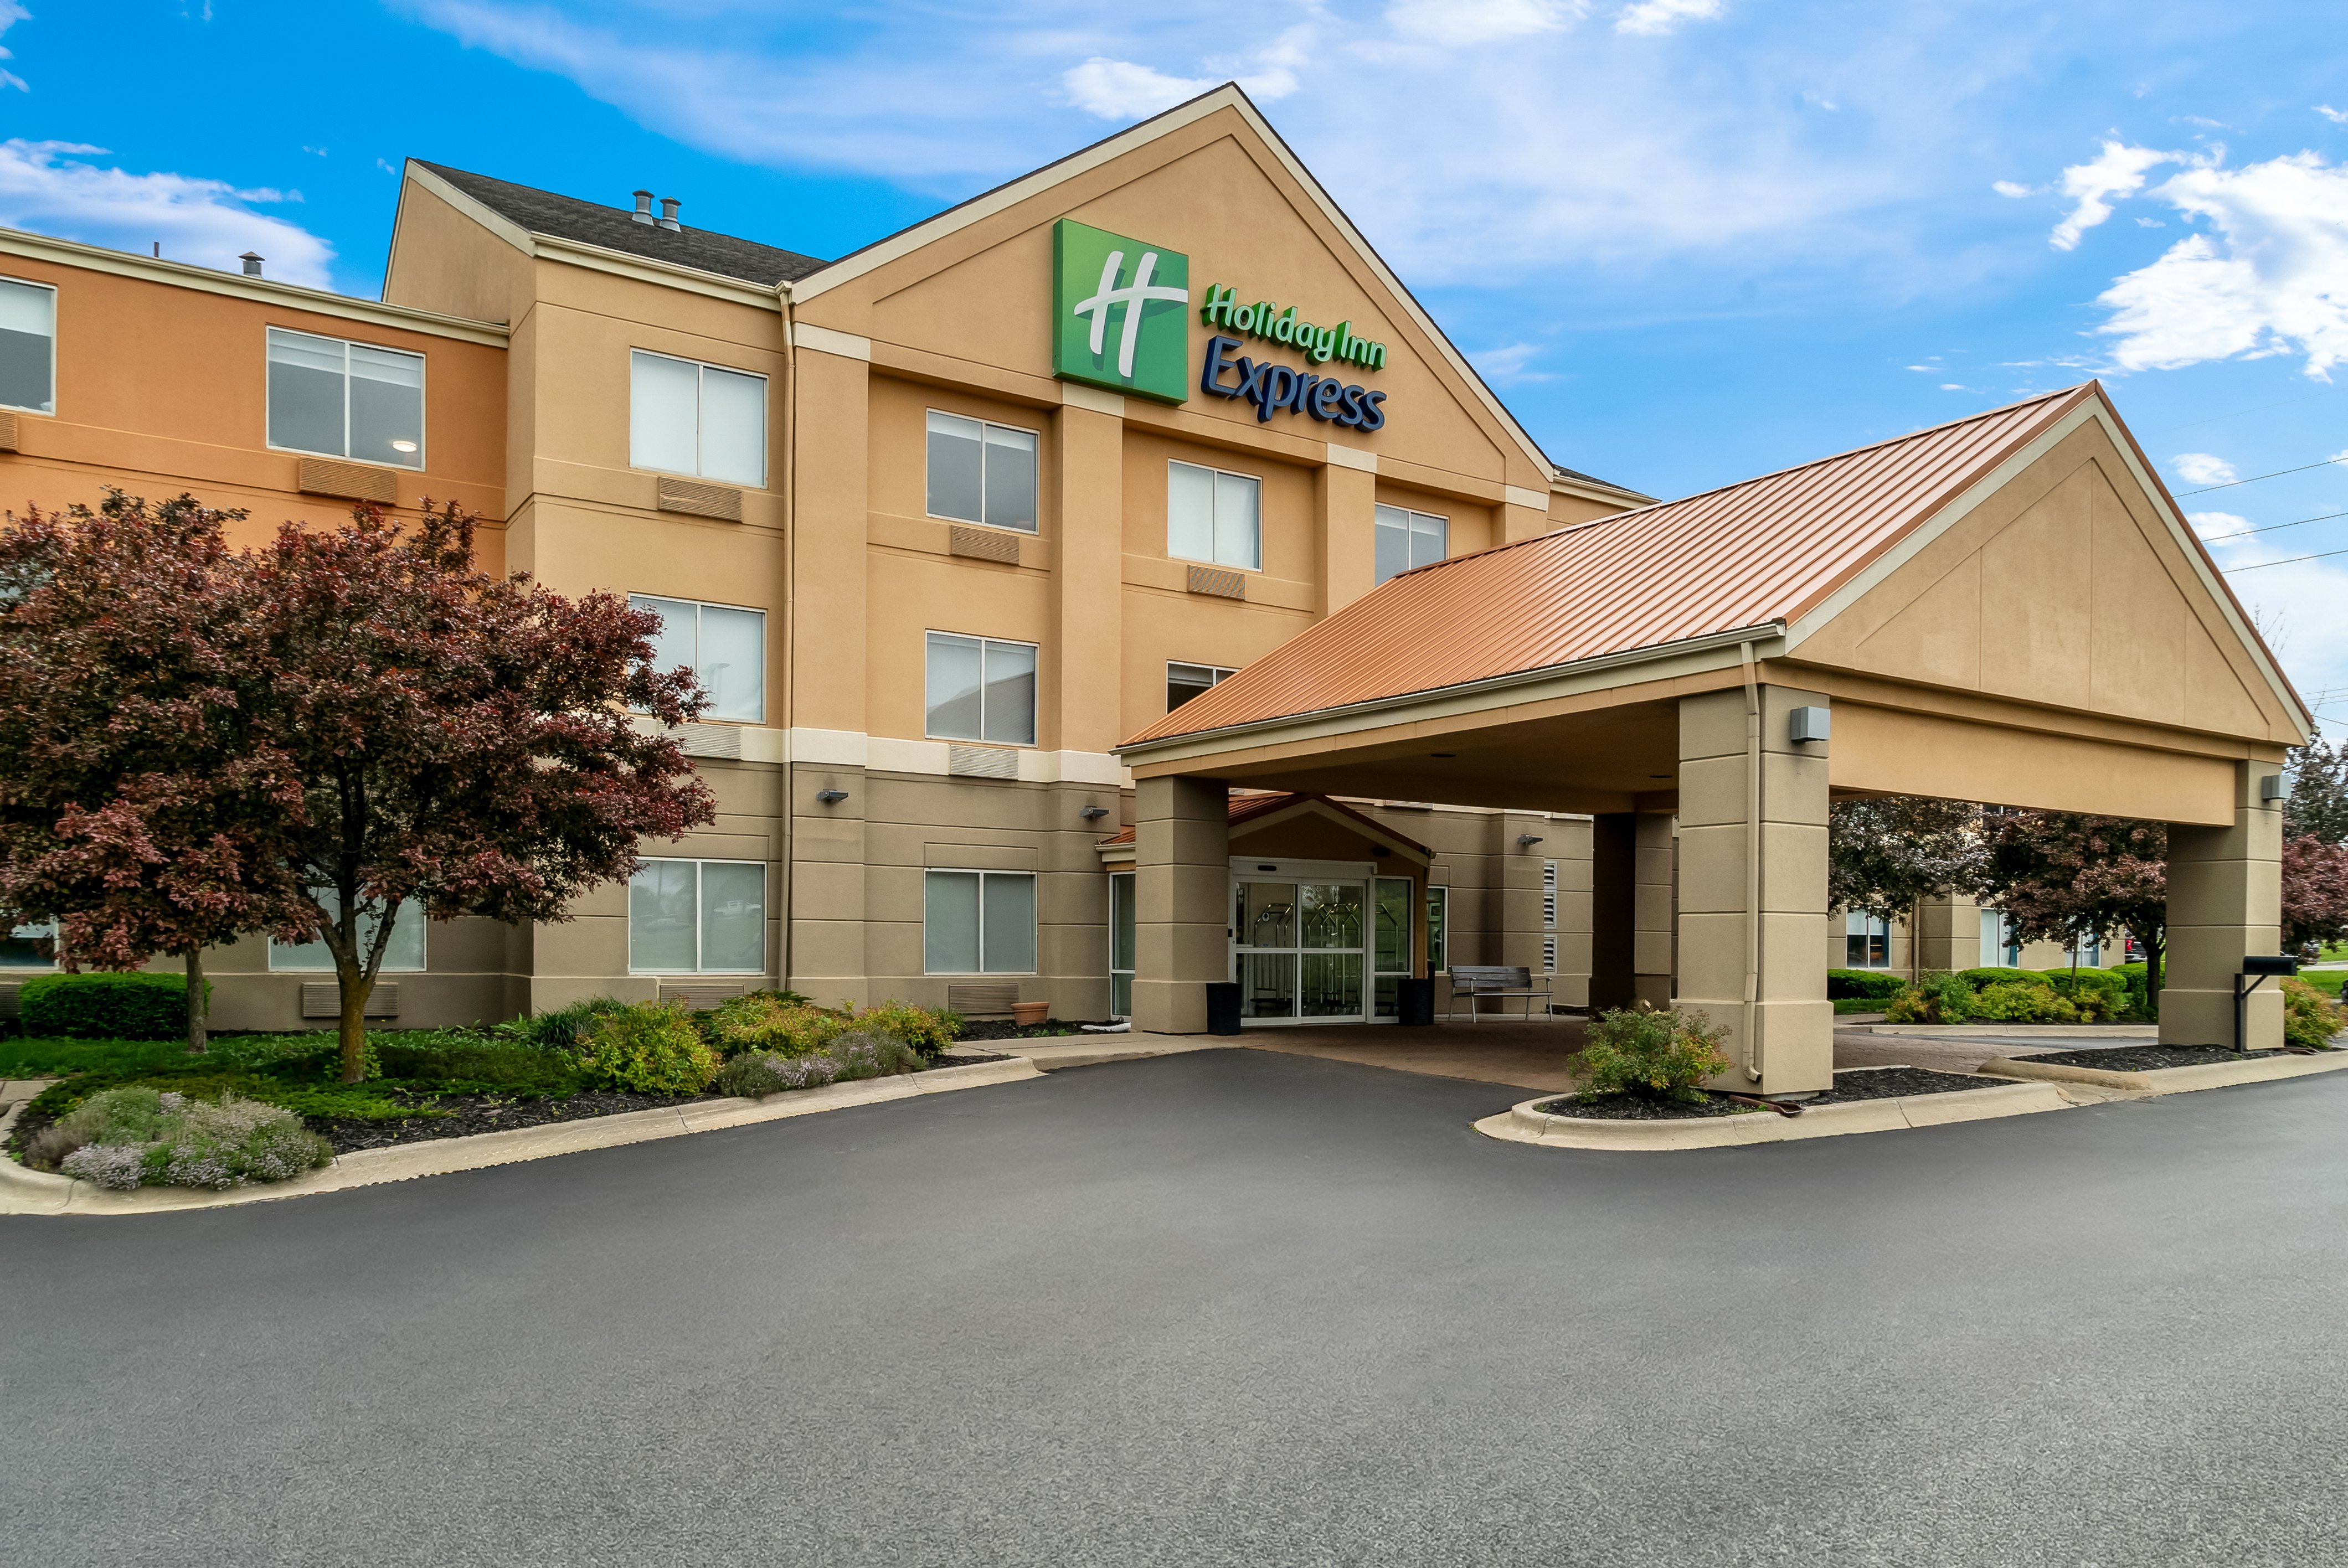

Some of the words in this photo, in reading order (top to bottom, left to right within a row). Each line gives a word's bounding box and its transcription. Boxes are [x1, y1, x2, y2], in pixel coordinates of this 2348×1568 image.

[1201, 283, 1336, 365] Holiday
[1336, 320, 1387, 371] Inn
[1201, 335, 1387, 432] Express
